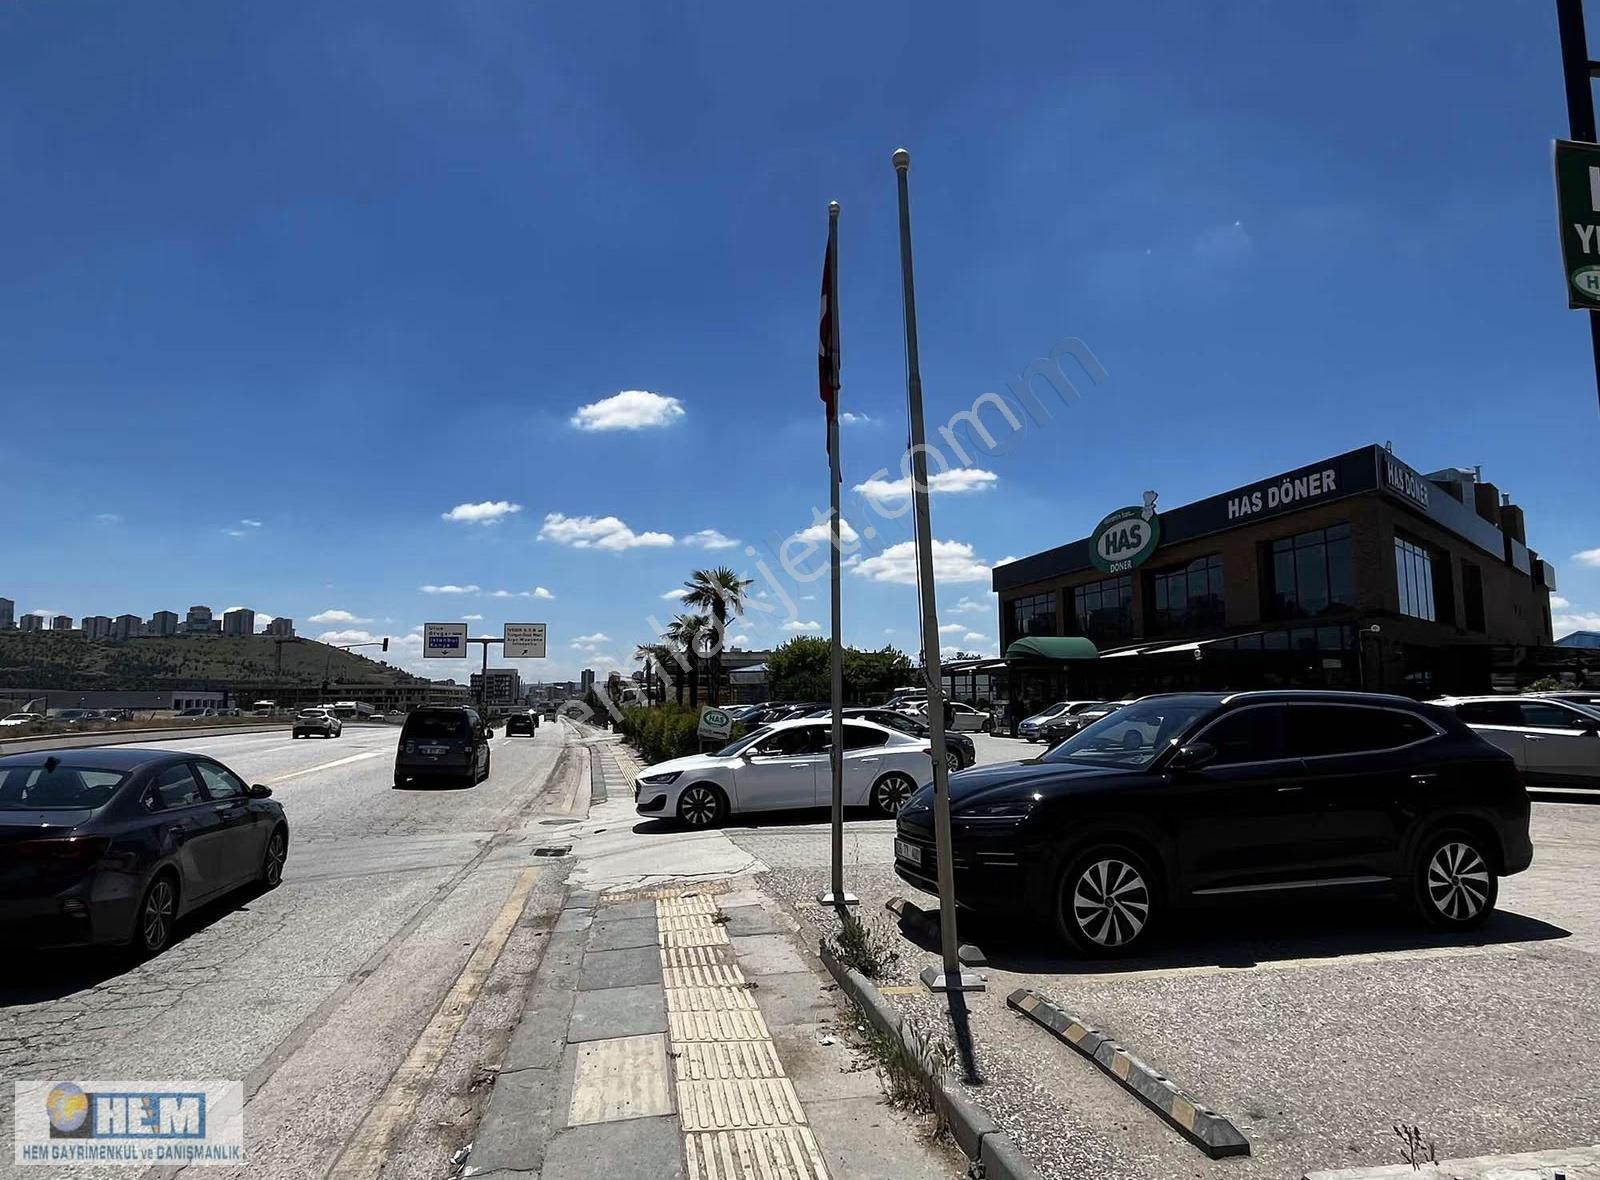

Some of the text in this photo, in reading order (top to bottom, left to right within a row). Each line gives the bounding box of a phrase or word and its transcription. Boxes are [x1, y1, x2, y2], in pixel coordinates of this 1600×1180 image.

[1387, 460, 1404, 491] HAS
[1227, 469, 1337, 520] HAS DÖNER
[1105, 524, 1142, 556] HAS
[709, 714, 724, 723] HAS
